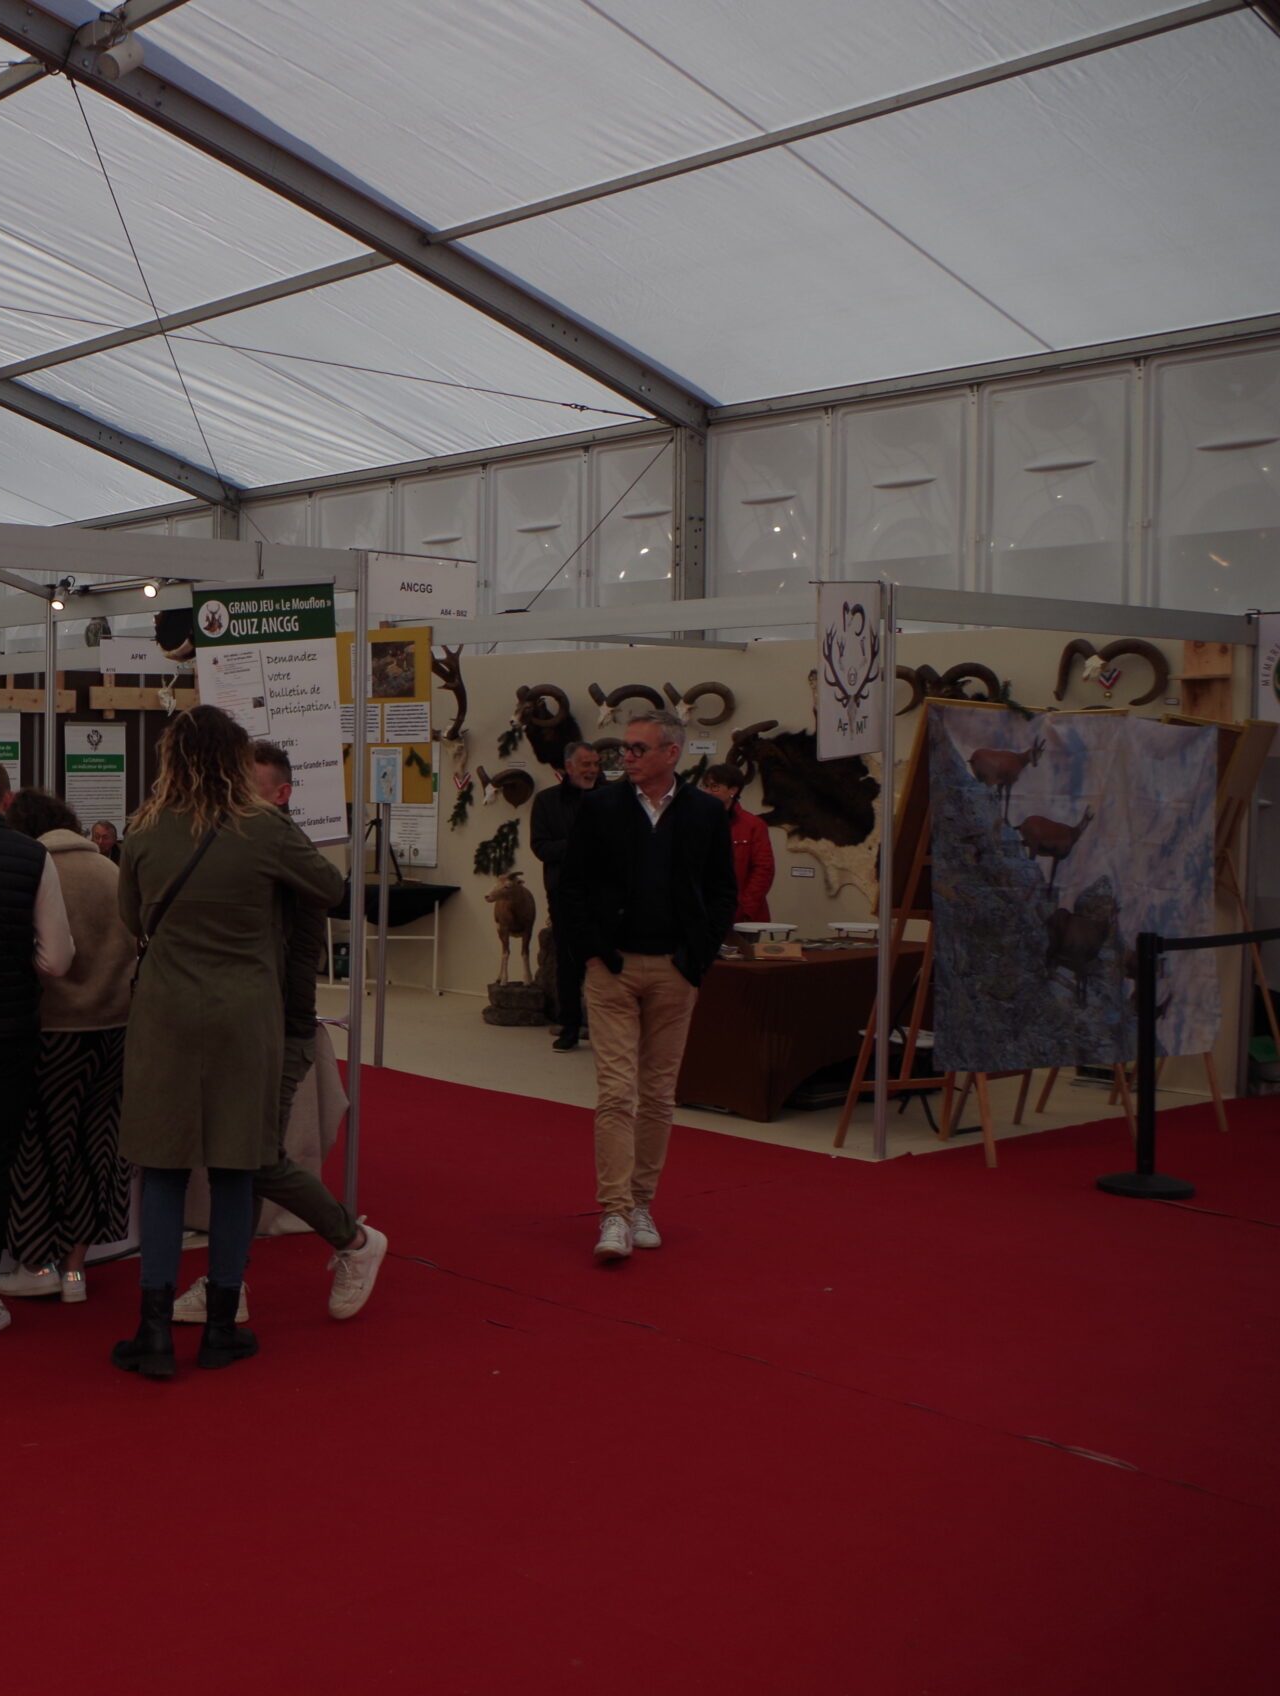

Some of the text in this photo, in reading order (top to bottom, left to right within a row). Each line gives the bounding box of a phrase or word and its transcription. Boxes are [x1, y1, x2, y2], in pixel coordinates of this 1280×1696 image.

[400, 581, 433, 594] ANCGG
[228, 600, 258, 614] GRAND
[259, 599, 274, 612] JEU
[281, 599, 291, 611] Le
[292, 596, 325, 610] Mouflon
[229, 615, 300, 638] QUIZ ANCGG
[266, 651, 318, 664] Demandez
[268, 672, 291, 681] votre
[269, 684, 321, 699] bulletin de
[270, 702, 332, 720] participation
[282, 737, 295, 748] prix
[303, 759, 322, 770] Grande
[322, 759, 339, 767] Faune
[307, 816, 326, 827] Grande
[326, 815, 342, 823] Faune
